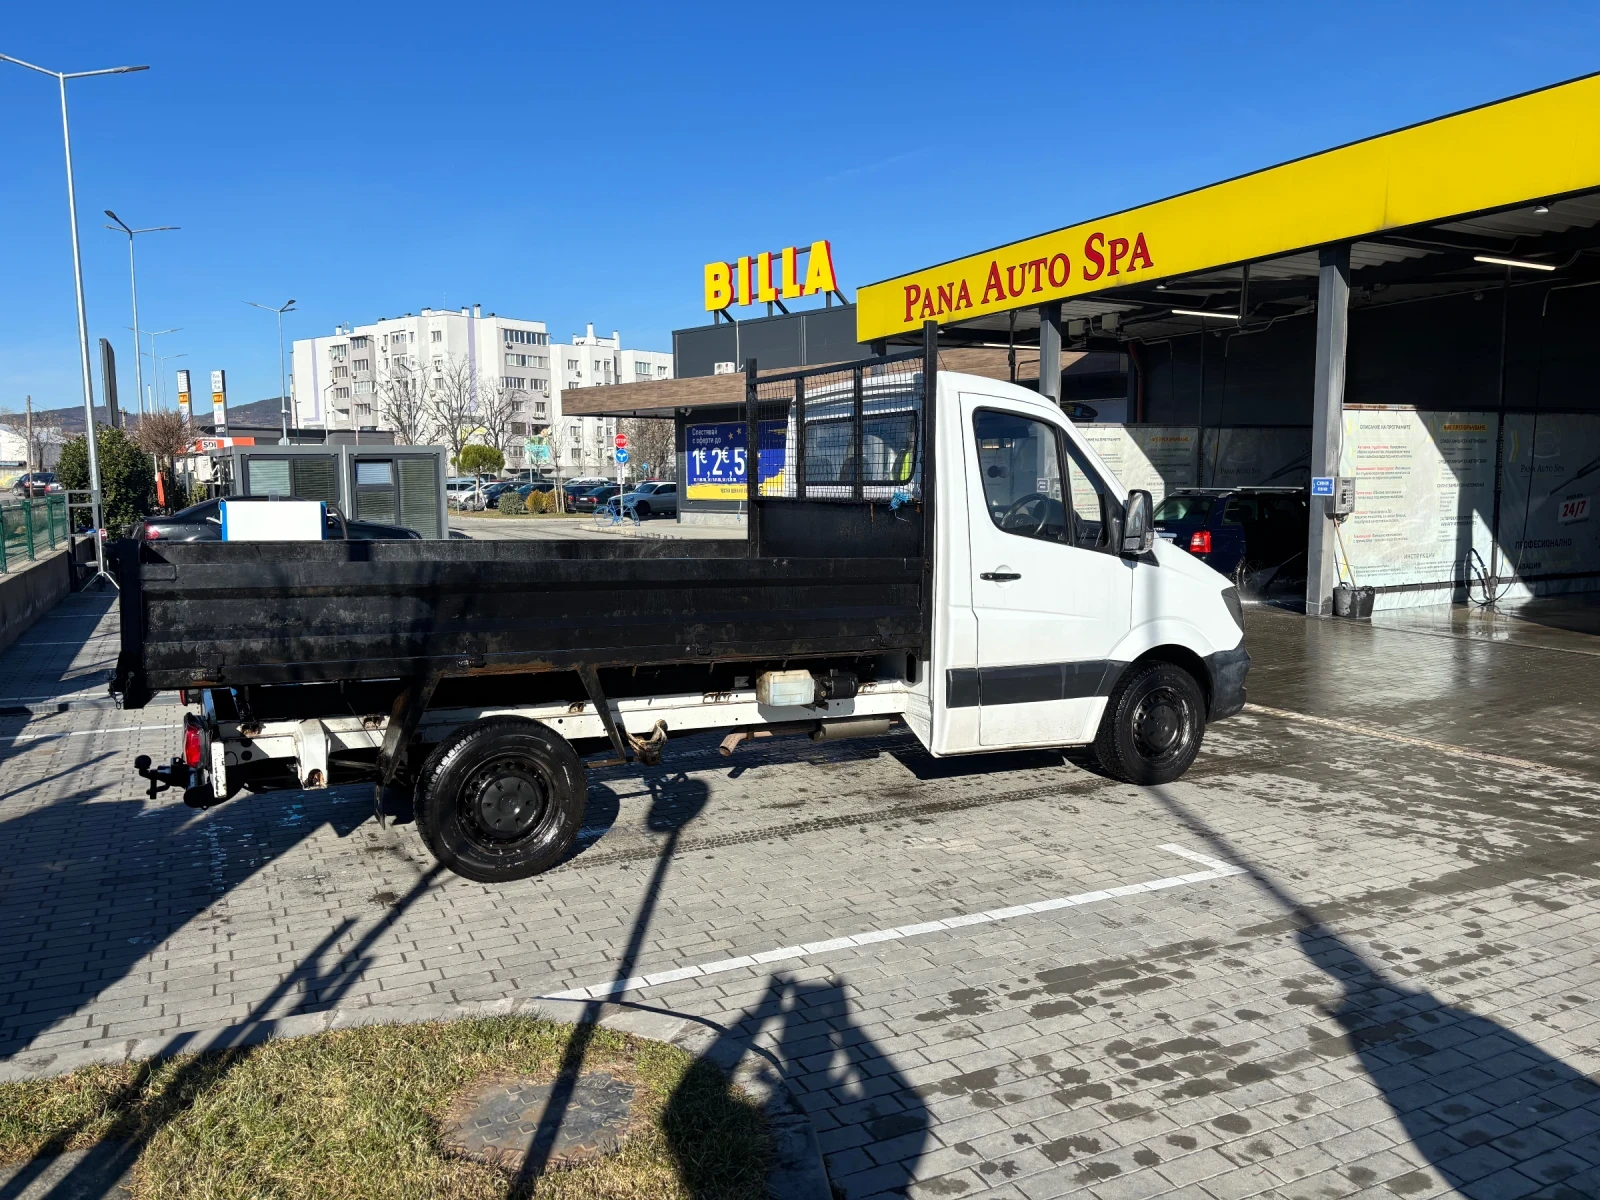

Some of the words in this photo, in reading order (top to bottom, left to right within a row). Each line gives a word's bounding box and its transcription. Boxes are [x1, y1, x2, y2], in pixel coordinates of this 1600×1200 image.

[704, 240, 836, 311] BILLA
[903, 277, 972, 322] PANA
[981, 253, 1070, 304] AUTO
[1083, 232, 1154, 282] SPA
[696, 437, 714, 446] оферти
[1536, 464, 1553, 472] AUTO
[1554, 463, 1564, 472] SPA
[1562, 500, 1586, 518] 24/7
[1515, 538, 1572, 550] ПРОФЕСИОНАЛНО
